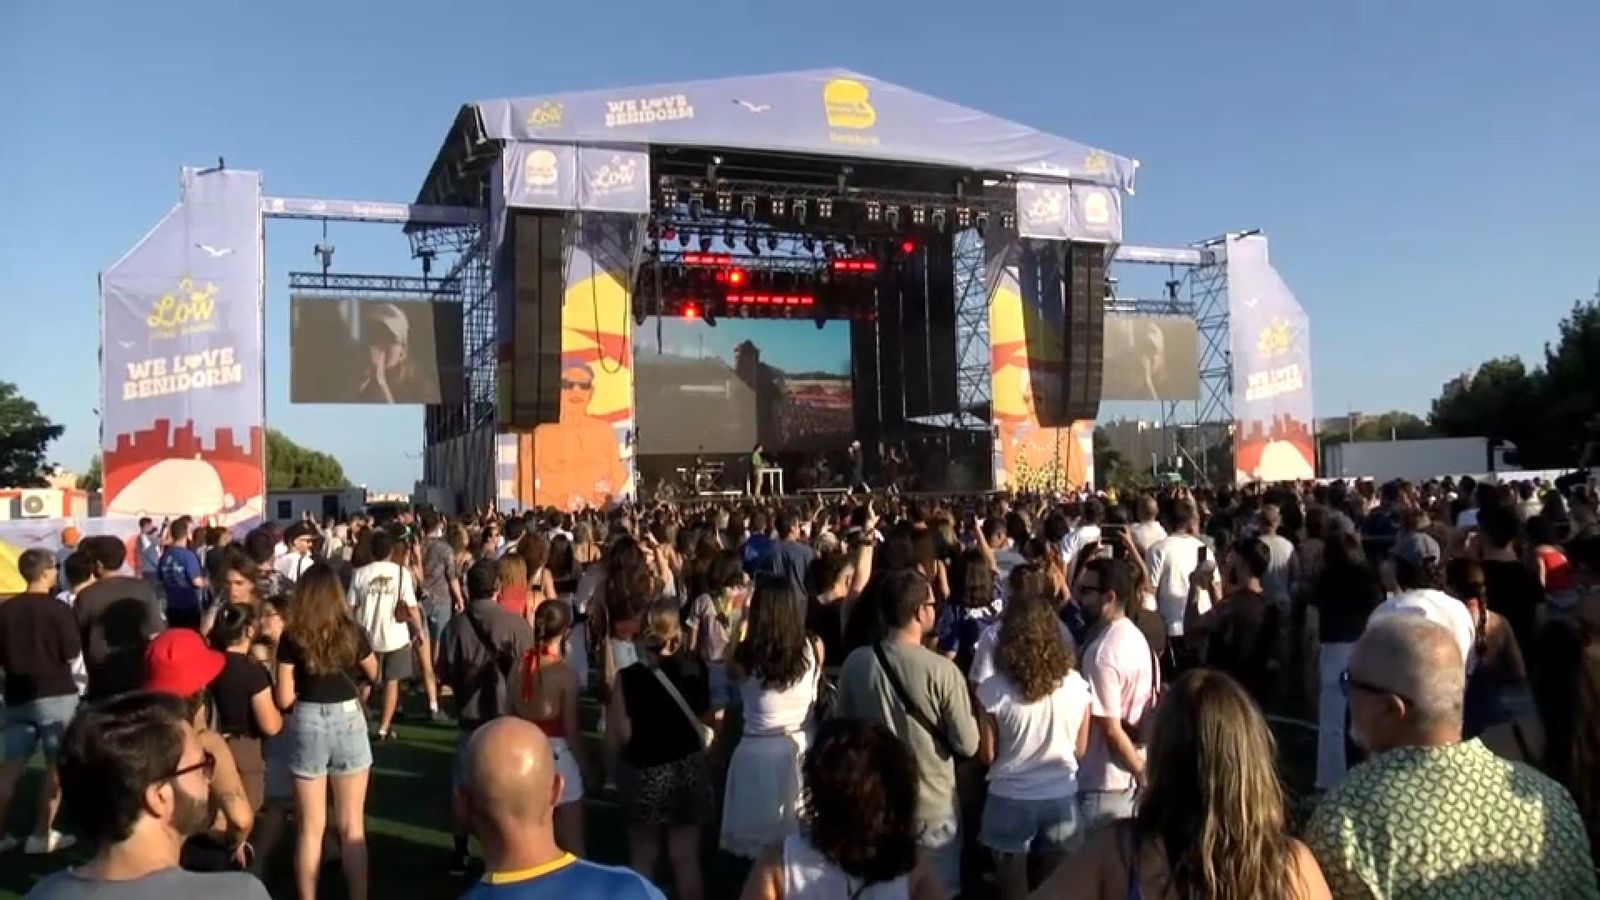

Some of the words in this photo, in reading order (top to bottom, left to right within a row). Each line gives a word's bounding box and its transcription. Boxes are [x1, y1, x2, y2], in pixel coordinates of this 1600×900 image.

[605, 105, 694, 127] BENIDORM
[607, 99, 636, 112] WE
[127, 357, 167, 379] WE
[122, 363, 242, 400] BENIDORM
